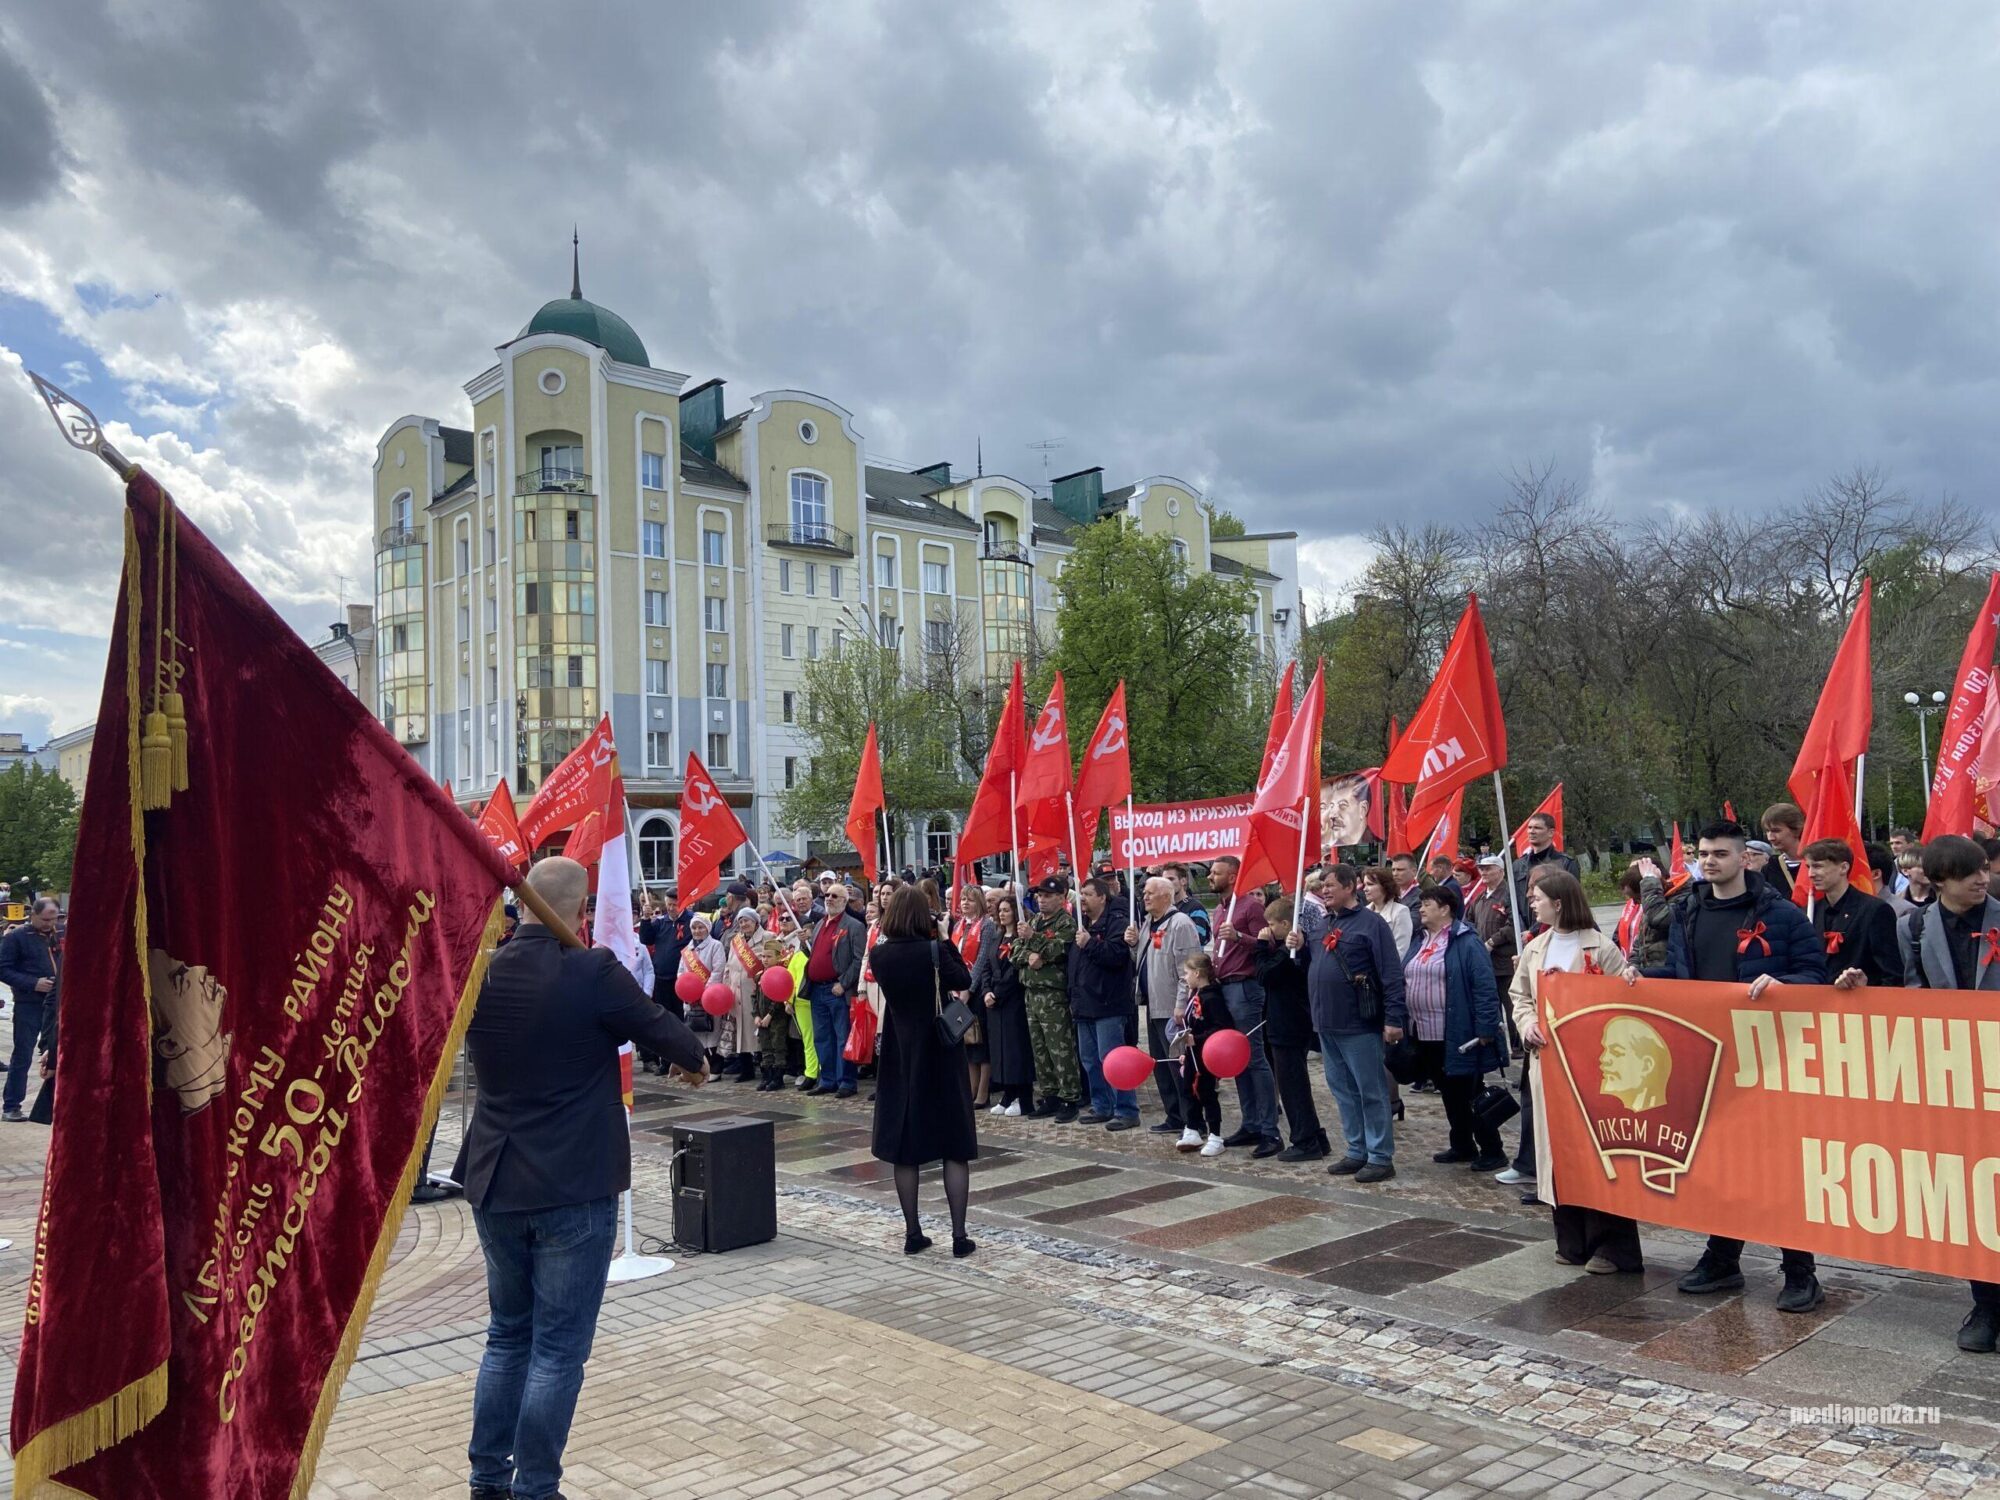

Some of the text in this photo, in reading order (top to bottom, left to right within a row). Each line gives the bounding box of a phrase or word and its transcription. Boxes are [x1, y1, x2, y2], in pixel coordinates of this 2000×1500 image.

[1114, 811, 1163, 830] ВЫХОД
[1168, 809, 1186, 824] ИЗ
[1121, 827, 1240, 858] СОЦИАЛИЗМ!
[283, 883, 354, 1022] РАЙОНУ
[1657, 1123, 1688, 1154] РФ
